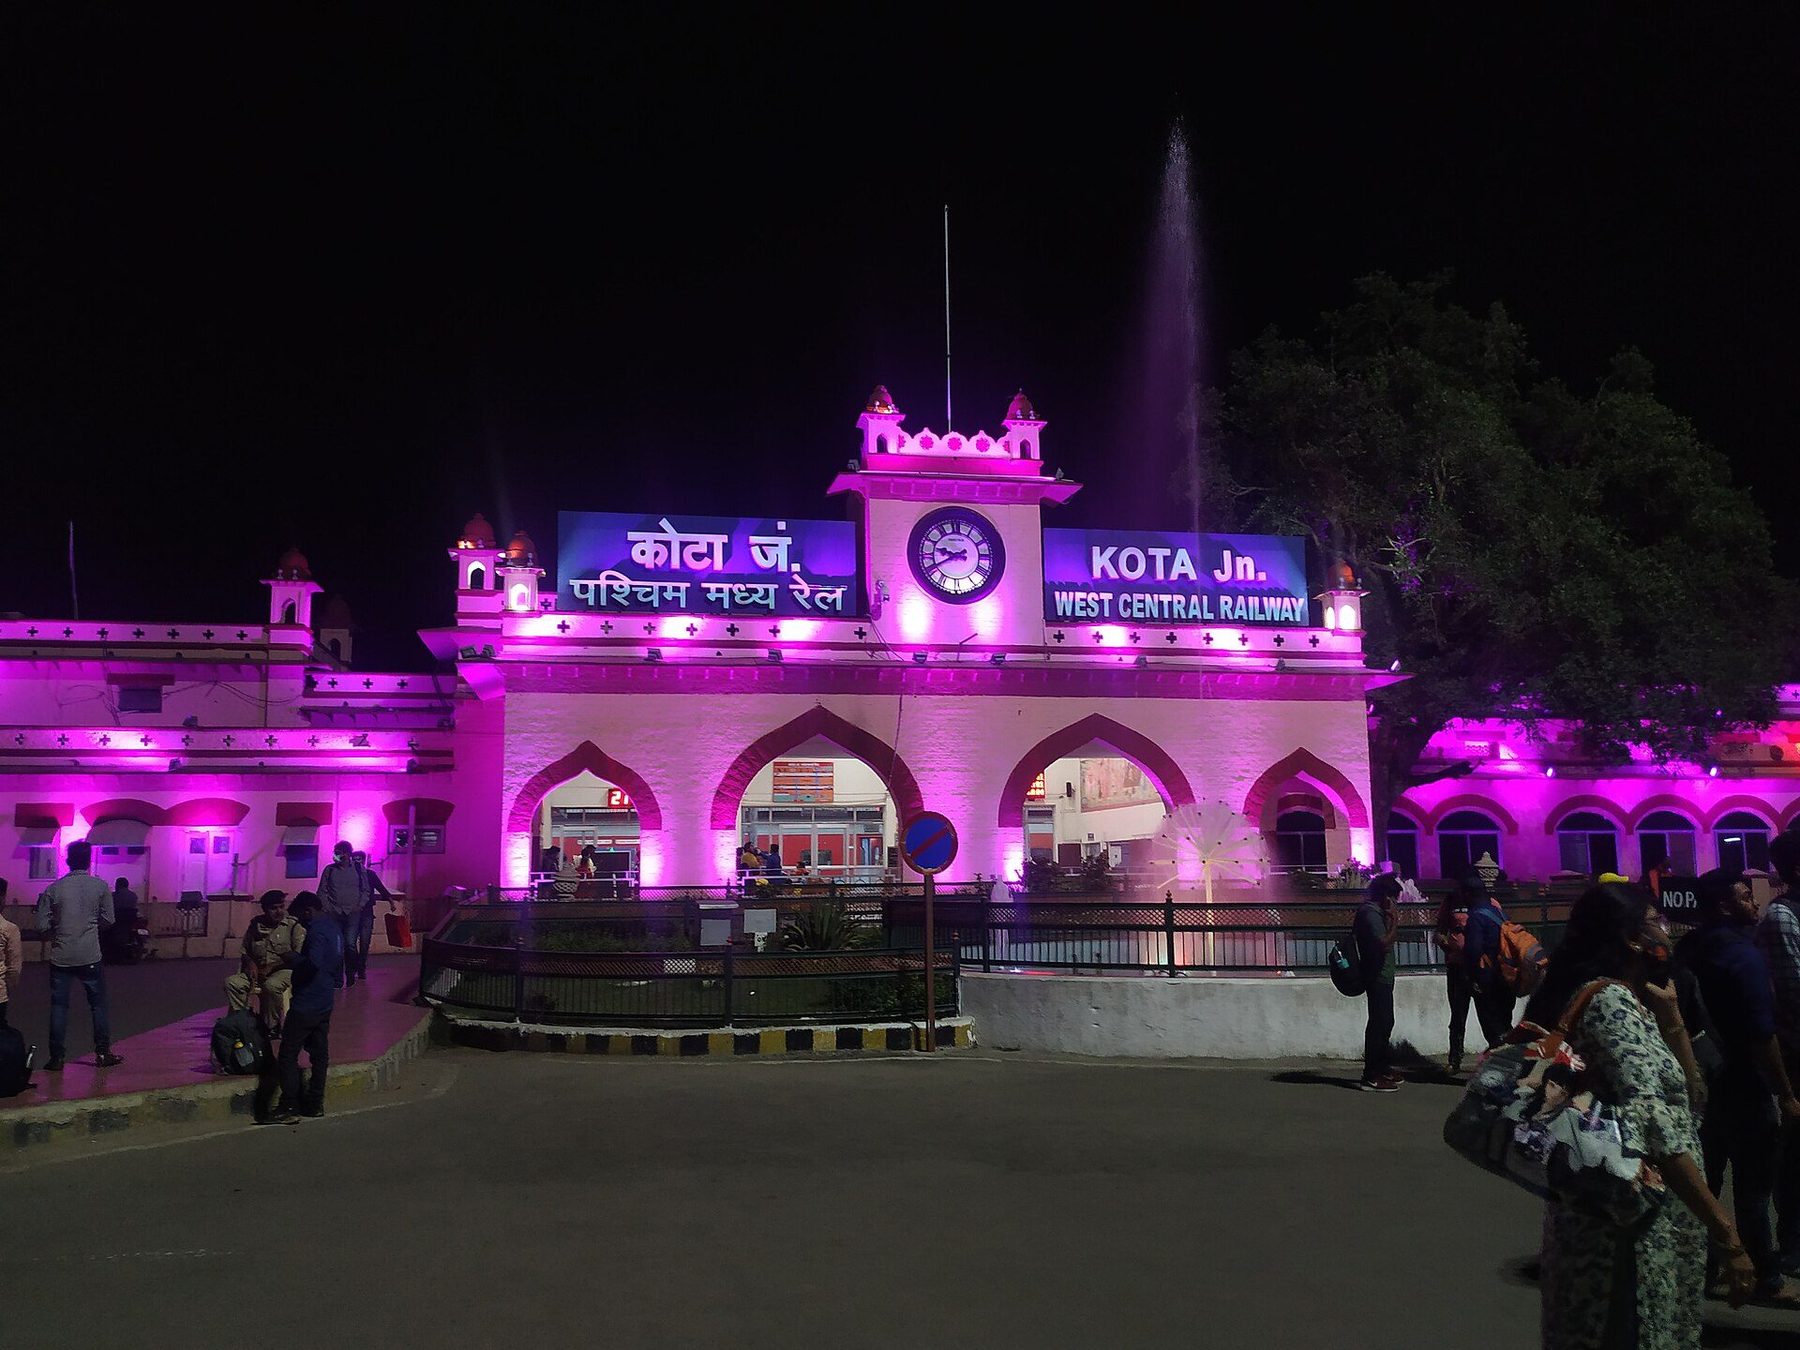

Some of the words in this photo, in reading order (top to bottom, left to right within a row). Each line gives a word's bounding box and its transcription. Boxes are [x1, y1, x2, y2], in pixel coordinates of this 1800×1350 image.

[627, 517, 728, 571] कोटा
[748, 521, 801, 572] जं.
[1092, 546, 1198, 582] KOTA
[1213, 550, 1267, 582] Jn.
[569, 570, 691, 608] पश्चिम
[701, 582, 779, 610] मध्य
[788, 573, 848, 611] रेल
[1054, 591, 1113, 617] WEST
[1118, 593, 1214, 620] CENTRAL
[1220, 595, 1305, 622] RAILWAY
